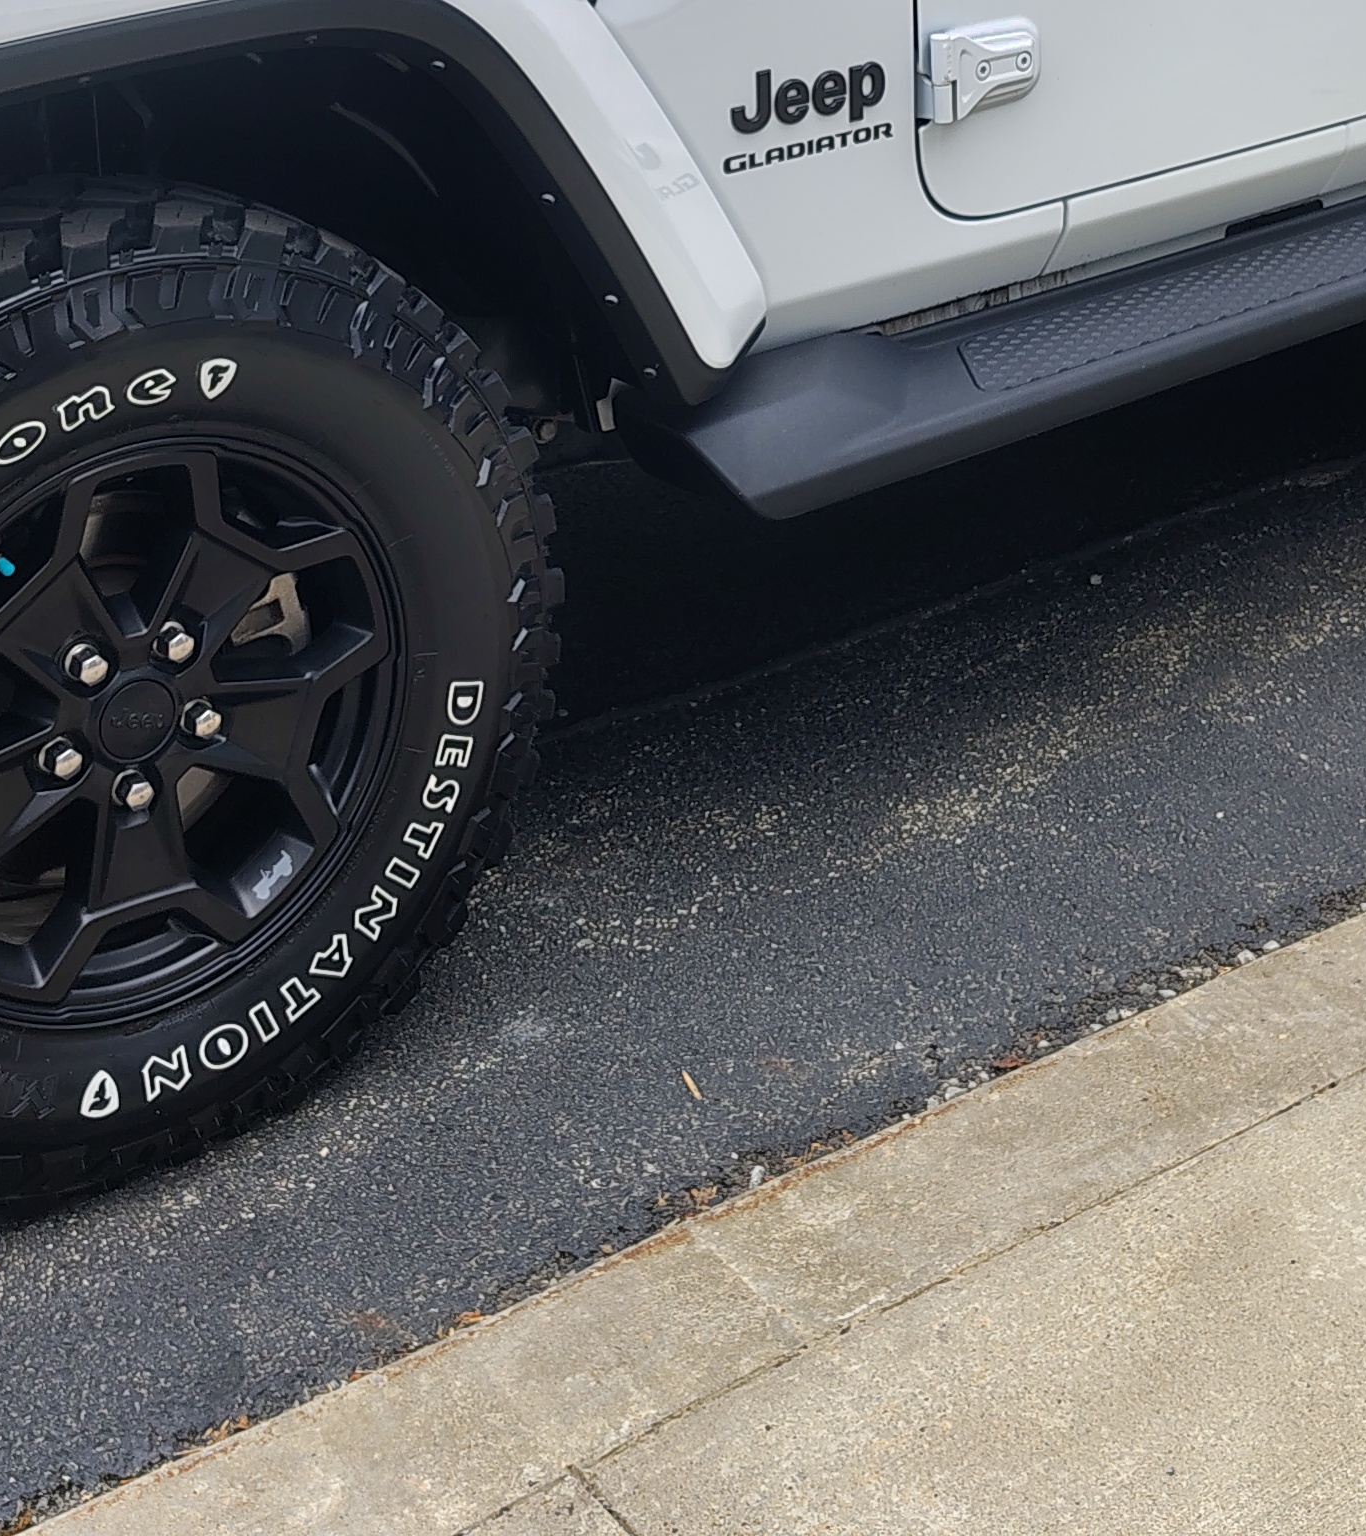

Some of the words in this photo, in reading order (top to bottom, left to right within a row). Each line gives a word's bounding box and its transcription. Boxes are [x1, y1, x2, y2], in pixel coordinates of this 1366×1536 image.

[730, 61, 886, 135] Jeep
[723, 122, 894, 175] GLADIATOR
[141, 680, 485, 1103] DESTINATION
